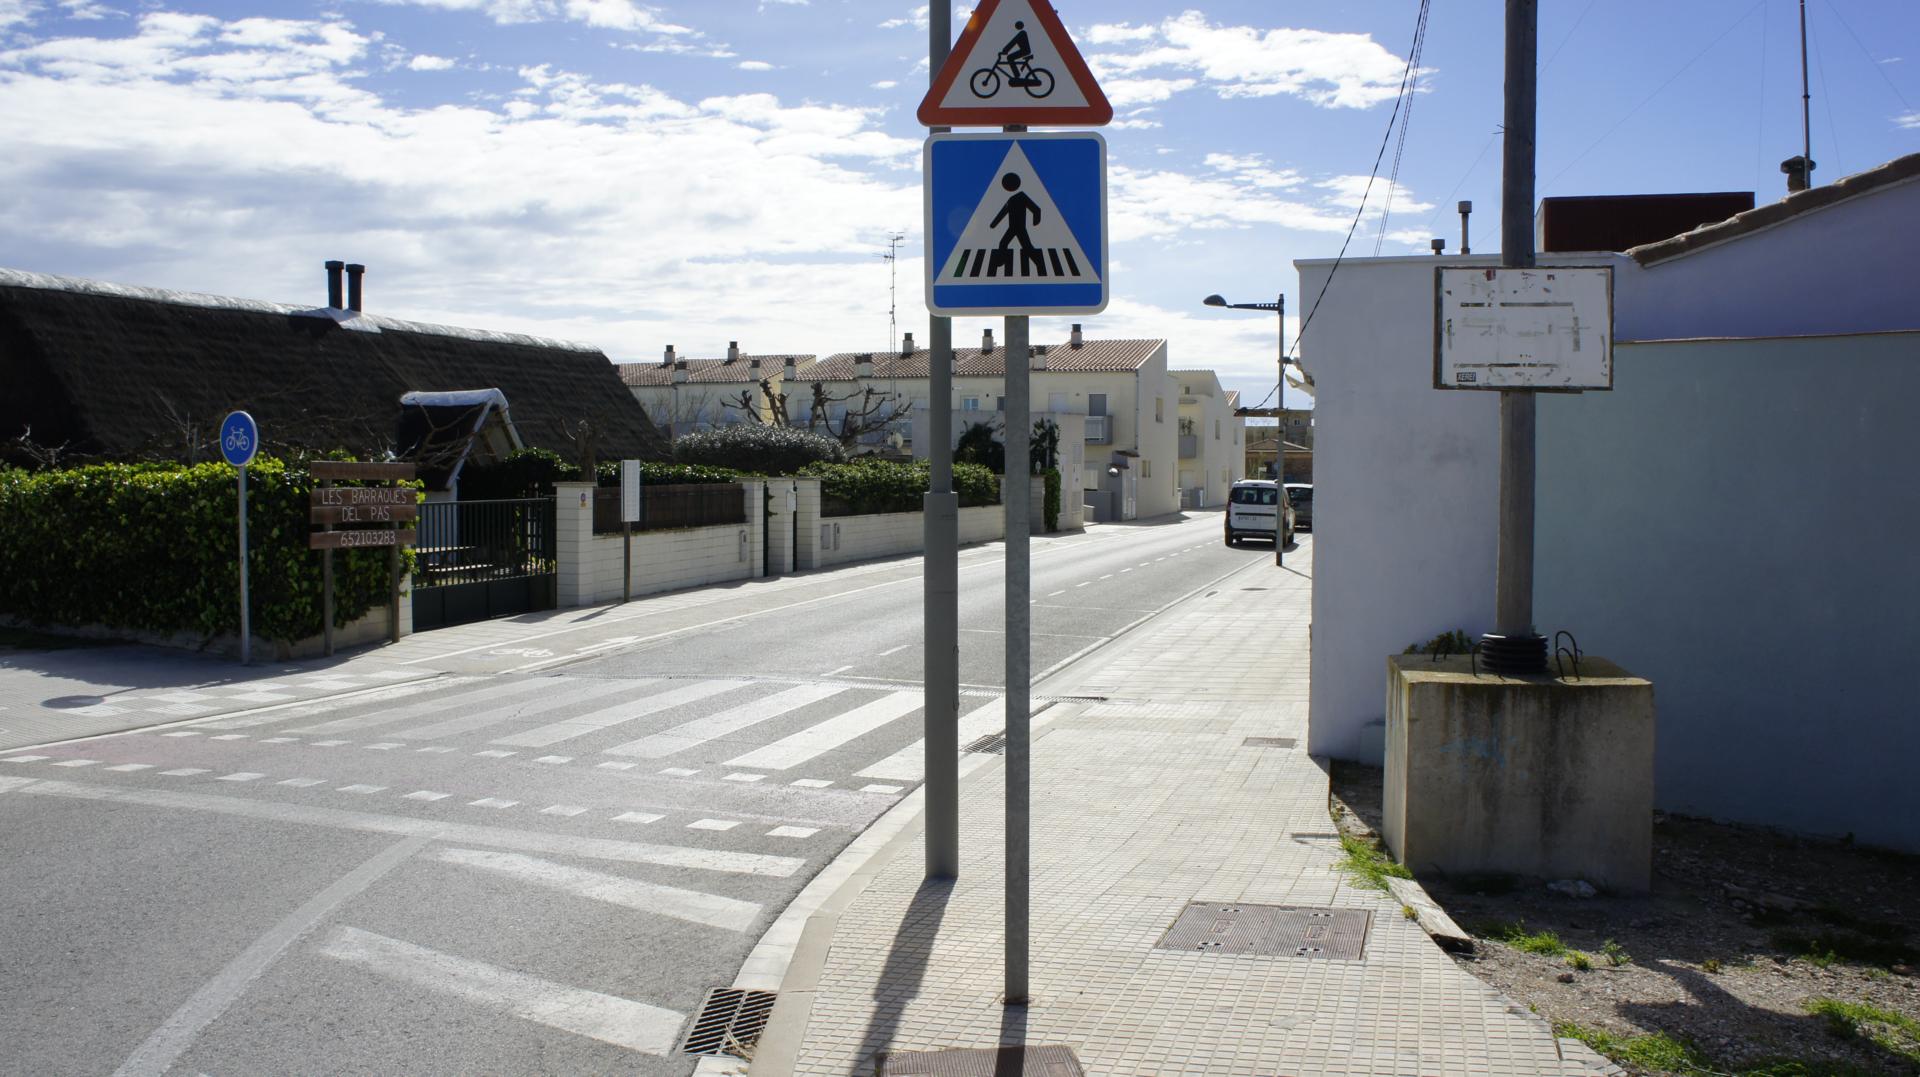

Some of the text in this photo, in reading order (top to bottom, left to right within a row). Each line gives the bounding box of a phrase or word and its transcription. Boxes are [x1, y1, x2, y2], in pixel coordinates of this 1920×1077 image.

[322, 488, 407, 505] LES BARRAQUES
[342, 506, 390, 522] DEL PAS
[340, 531, 396, 546] 652103283
